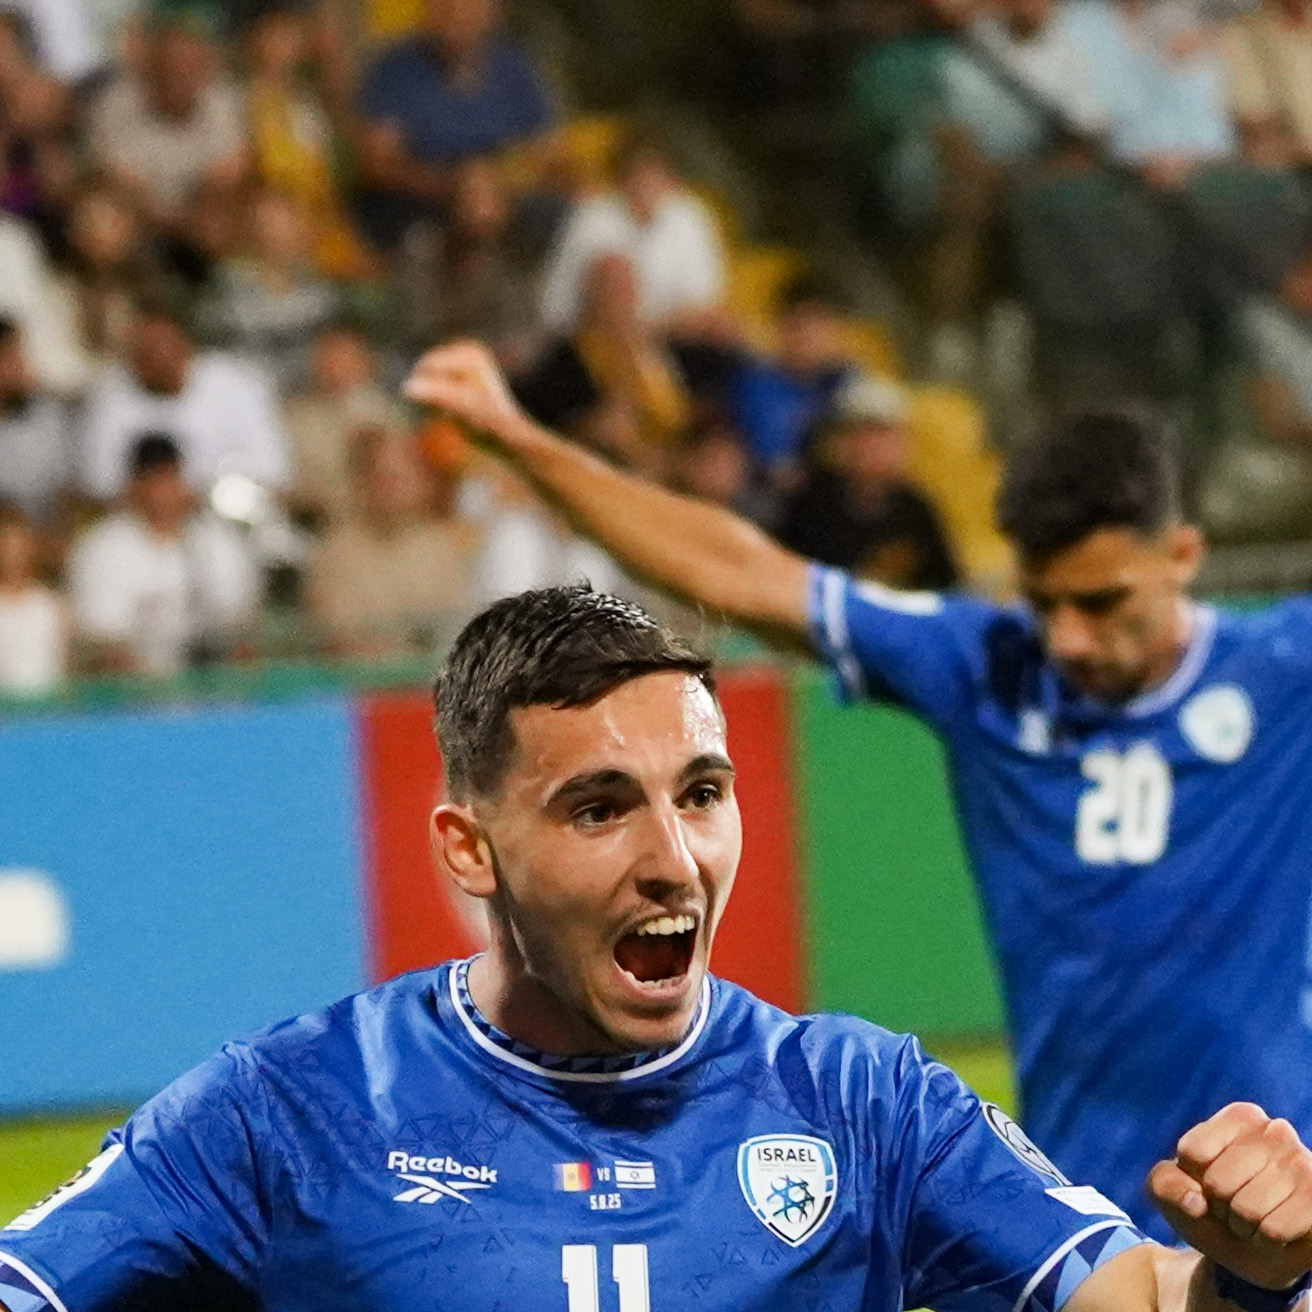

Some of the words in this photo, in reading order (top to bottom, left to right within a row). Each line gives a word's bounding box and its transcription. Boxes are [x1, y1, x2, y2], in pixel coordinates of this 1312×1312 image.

[1075, 742, 1174, 863] 20
[387, 1150, 498, 1183] Reebok
[757, 1147, 816, 1162] ISRAEL
